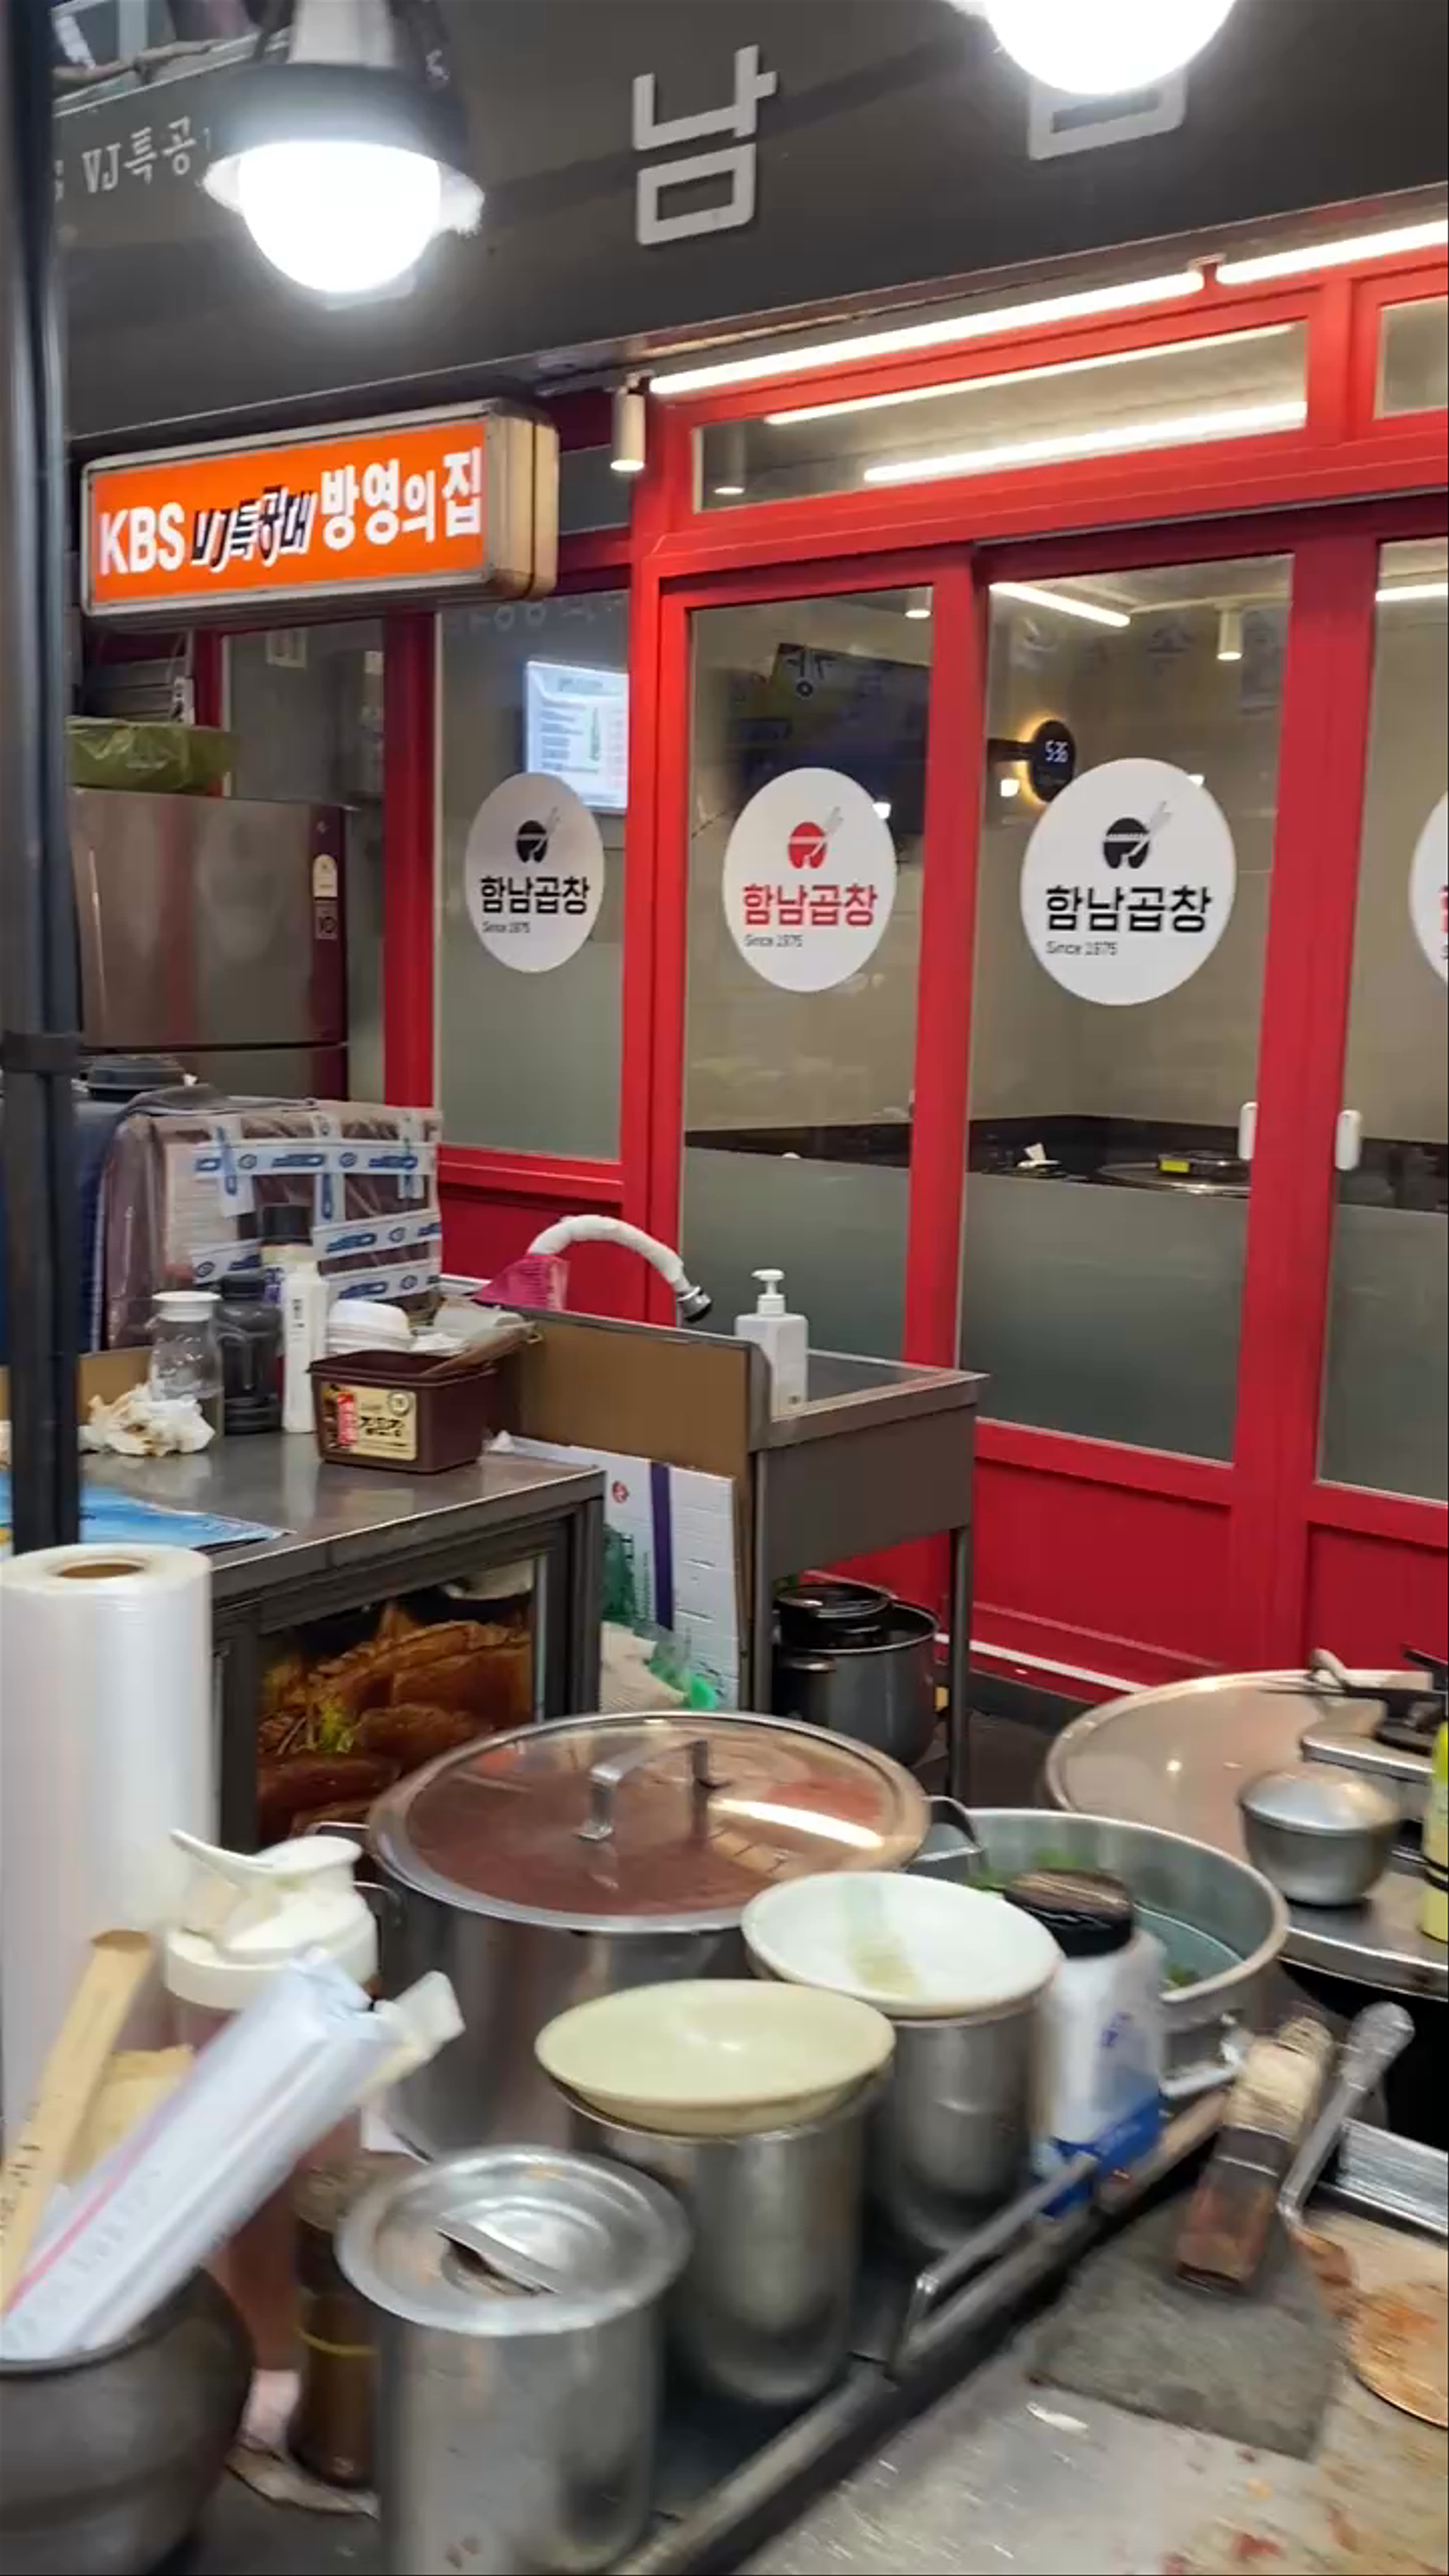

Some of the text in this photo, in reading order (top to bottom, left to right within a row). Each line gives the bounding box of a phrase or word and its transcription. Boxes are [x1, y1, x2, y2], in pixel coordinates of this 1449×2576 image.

[81, 116, 211, 193] VJ특공
[633, 45, 778, 245] 남
[100, 503, 185, 576] KBS
[480, 876, 591, 915] 함남곱창
[743, 883, 878, 927] 함남곱창
[1045, 885, 1212, 934] 함남곱창
[1046, 941, 1082, 956] Since
